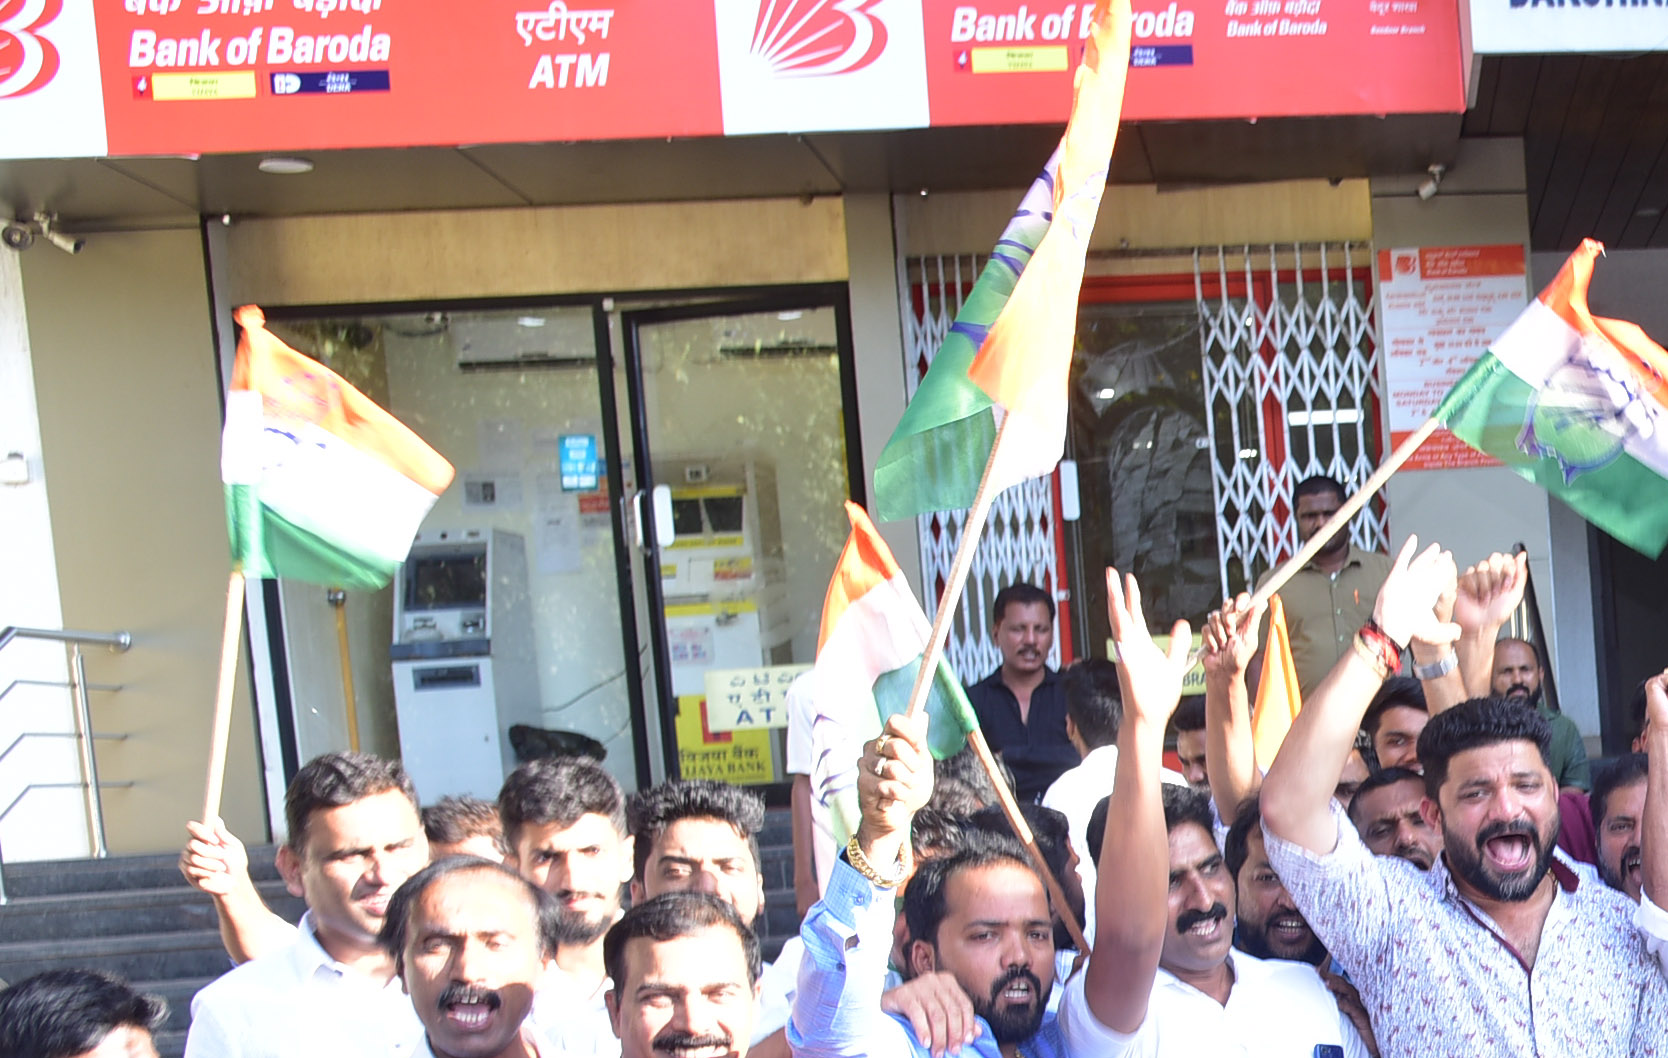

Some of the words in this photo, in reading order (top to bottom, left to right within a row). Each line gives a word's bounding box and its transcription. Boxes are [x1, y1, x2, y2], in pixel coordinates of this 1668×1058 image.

[515, 0, 614, 47] एटीएम
[951, 6, 1037, 42] Bank
[1041, 4, 1076, 40] of
[1079, 2, 1194, 40] Broda
[1227, 19, 1262, 37] Bank
[1263, 19, 1278, 37] of
[1279, 18, 1328, 36] Baroda
[129, 29, 221, 67] Bank
[226, 27, 263, 65] of
[267, 24, 391, 64] Baroda
[528, 53, 610, 89] ATM
[682, 764, 724, 777] IJAYA
[727, 760, 765, 773] BANK
